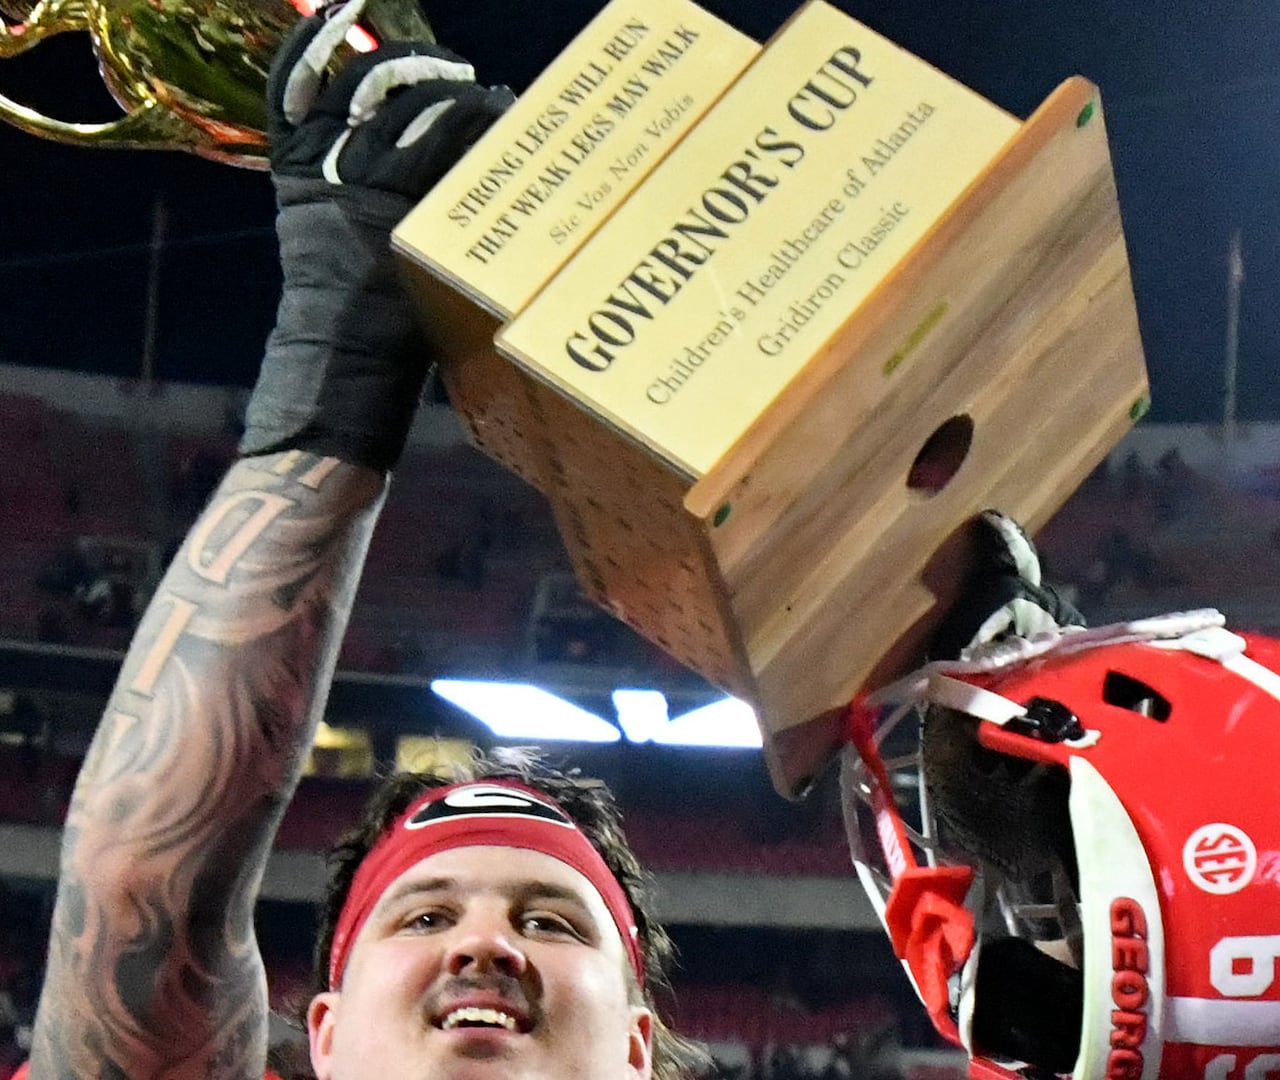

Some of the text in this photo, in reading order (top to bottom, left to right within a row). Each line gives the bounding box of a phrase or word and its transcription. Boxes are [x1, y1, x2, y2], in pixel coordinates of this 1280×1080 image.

[448, 17, 650, 229] STRONG LEGS WILL RUN
[465, 24, 700, 265] THAT WEAK LEGS MAY WALK
[548, 94, 695, 245] Sic Vos Non Vobis
[565, 45, 875, 373] GOVERNOR'S CUP
[646, 101, 936, 405] Children's Healthcare of Atlanta
[758, 201, 910, 358] Gridiron Classic
[1191, 829, 1250, 888] SEC
